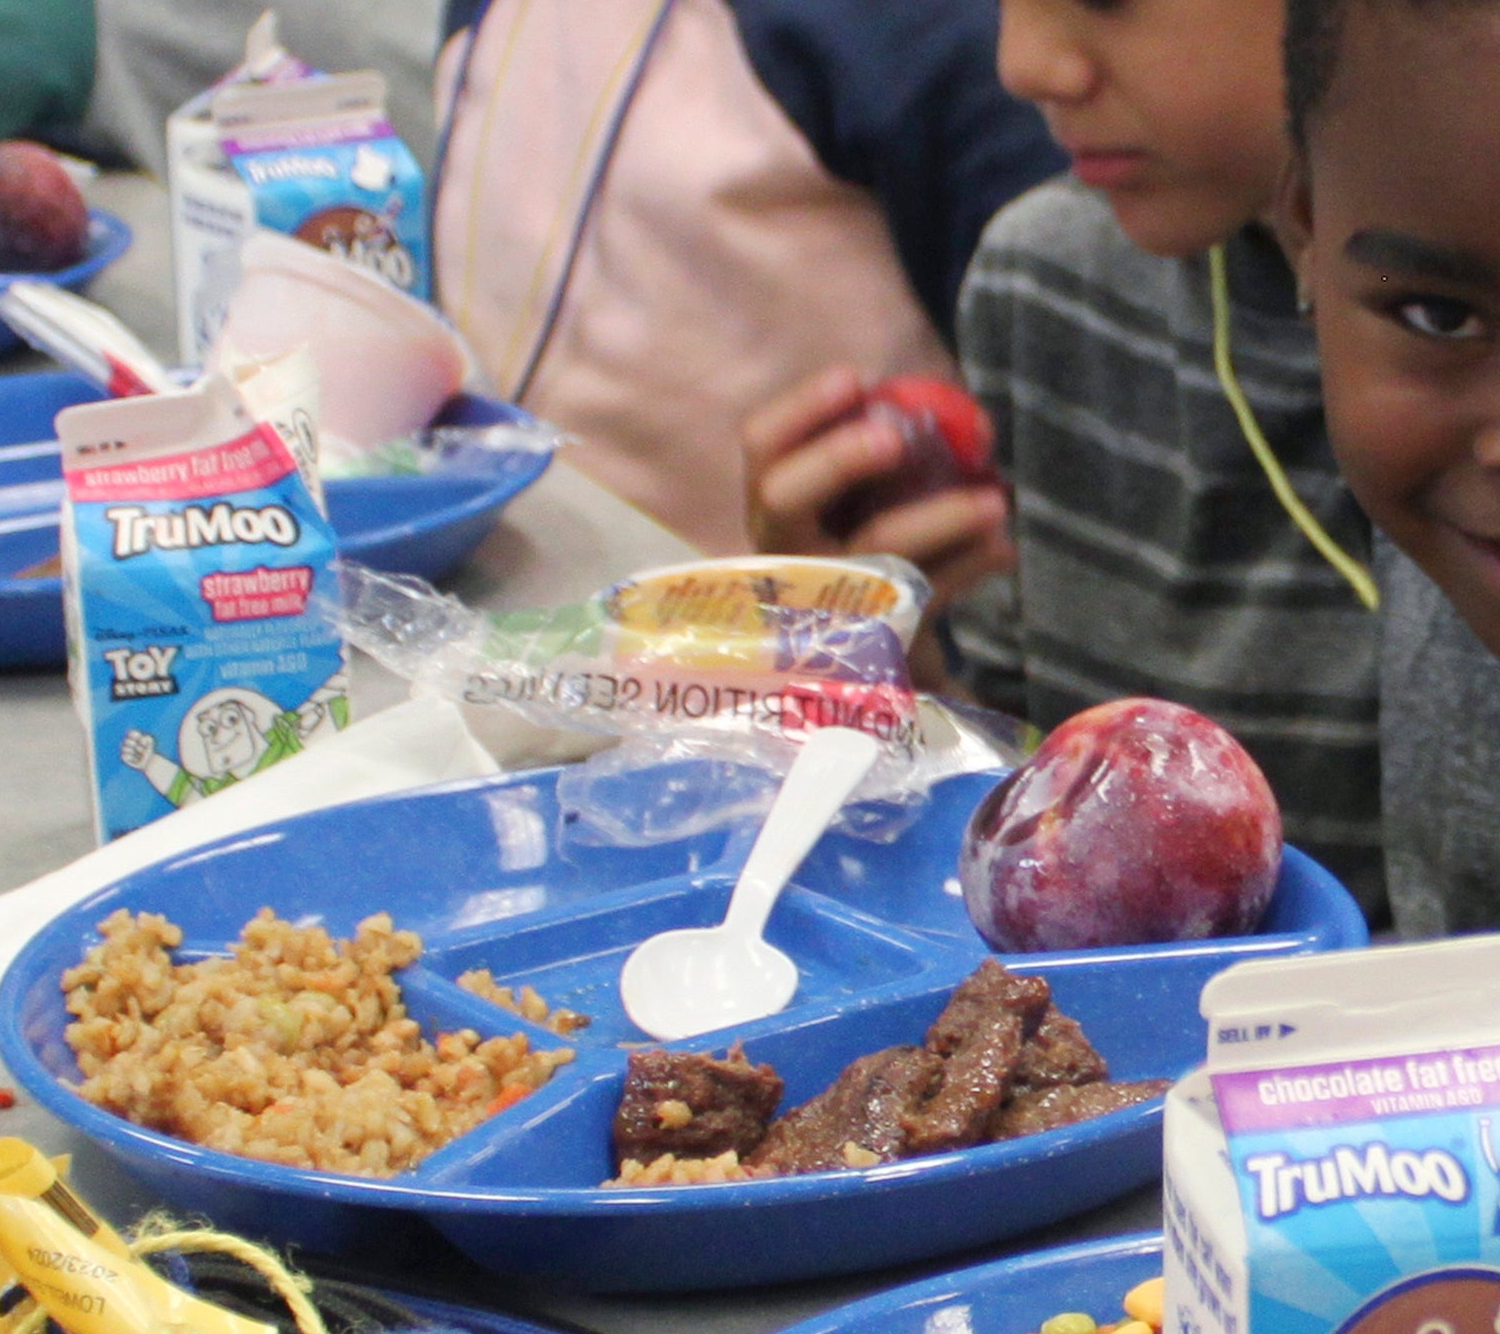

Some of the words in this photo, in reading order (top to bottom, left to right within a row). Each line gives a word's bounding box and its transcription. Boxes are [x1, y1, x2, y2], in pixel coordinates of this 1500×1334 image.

[85, 462, 189, 487] strawberry
[106, 505, 298, 558] TruMoo
[203, 569, 311, 598] strawberry
[113, 679, 175, 698] STORY
[1217, 1028, 1251, 1045] SELL
[1258, 1063, 1404, 1107] chocolate
[1406, 1056, 1450, 1092] fat
[1370, 1091, 1443, 1115] VITAMIN
[1246, 1138, 1470, 1221] TruMoo
